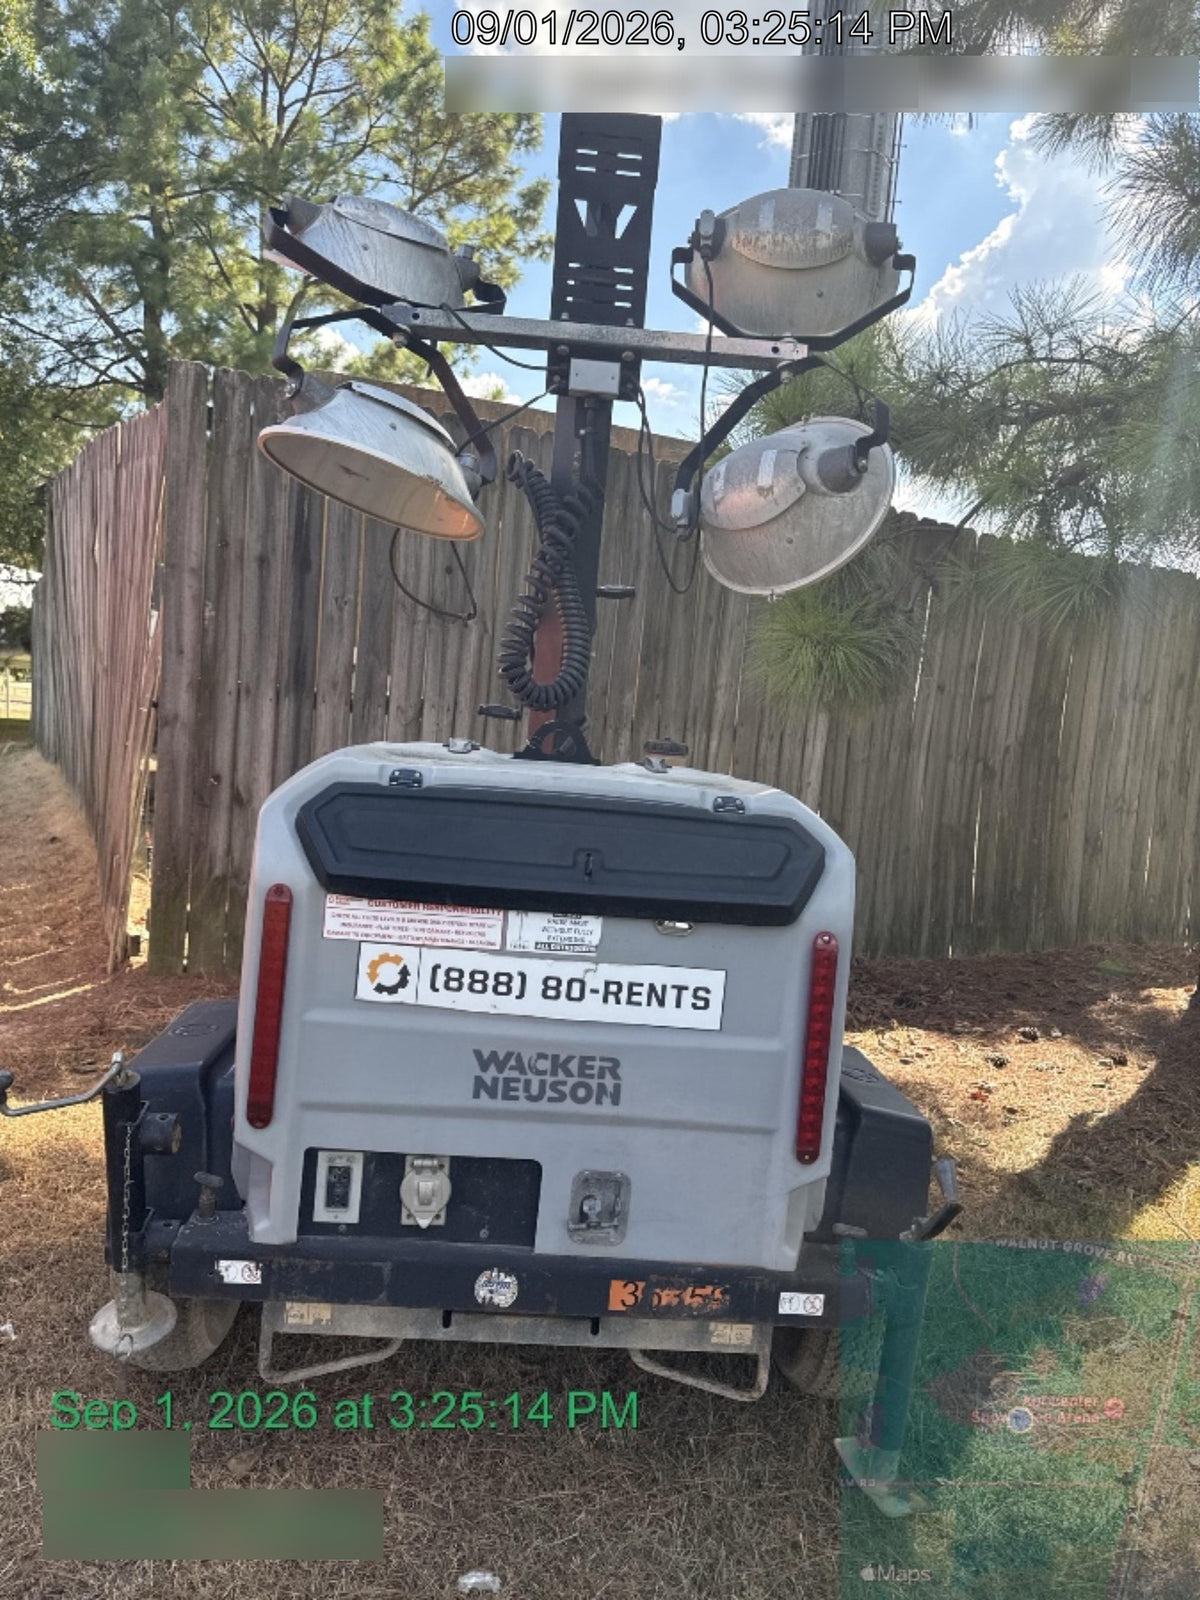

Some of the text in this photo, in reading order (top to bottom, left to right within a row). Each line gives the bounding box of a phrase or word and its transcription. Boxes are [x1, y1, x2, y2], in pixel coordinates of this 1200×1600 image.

[429, 964, 712, 1011] (888) 80-RENTS
[473, 1049, 622, 1081] WACKER
[472, 1075, 622, 1106] NEUSON
